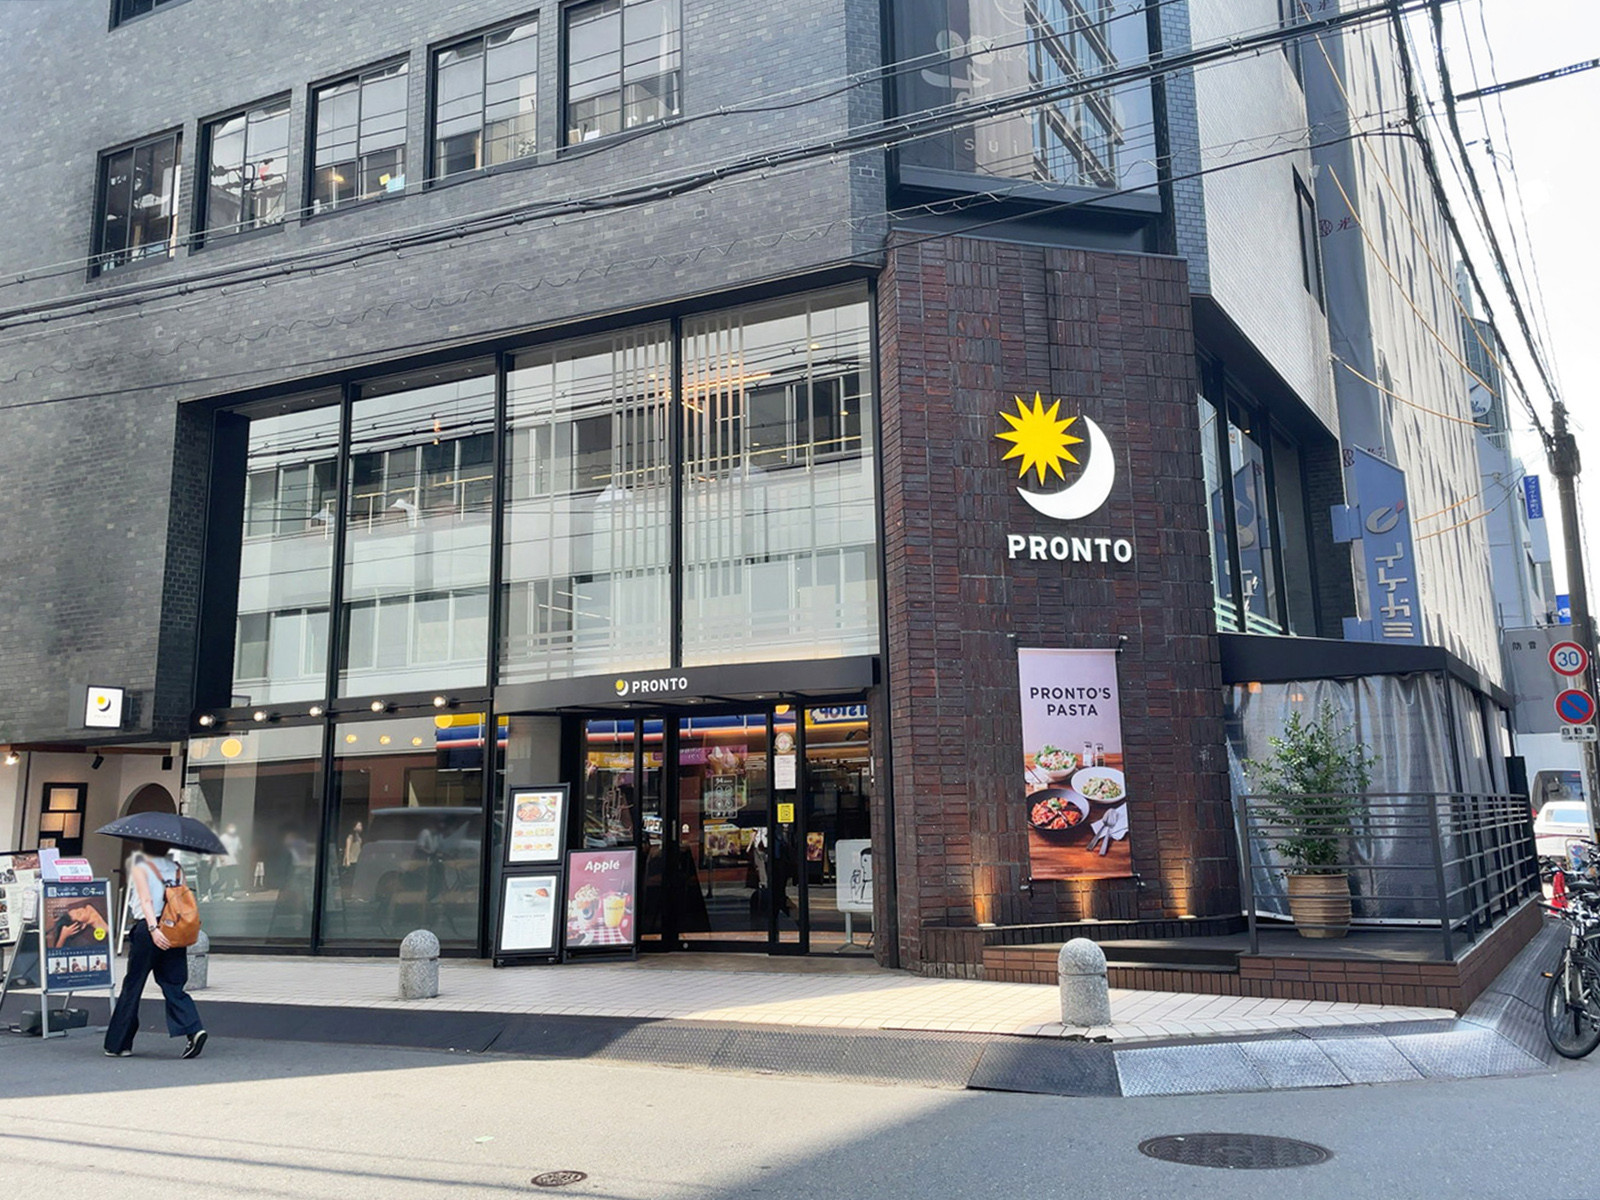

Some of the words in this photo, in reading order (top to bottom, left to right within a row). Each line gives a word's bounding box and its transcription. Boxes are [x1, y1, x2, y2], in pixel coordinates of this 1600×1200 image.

[1007, 535, 1133, 563] PRONTO
[1557, 651, 1580, 667] 30
[632, 677, 688, 693] PRONTO
[1030, 687, 1111, 700] PRONTO'S
[1047, 703, 1099, 717] PASTA
